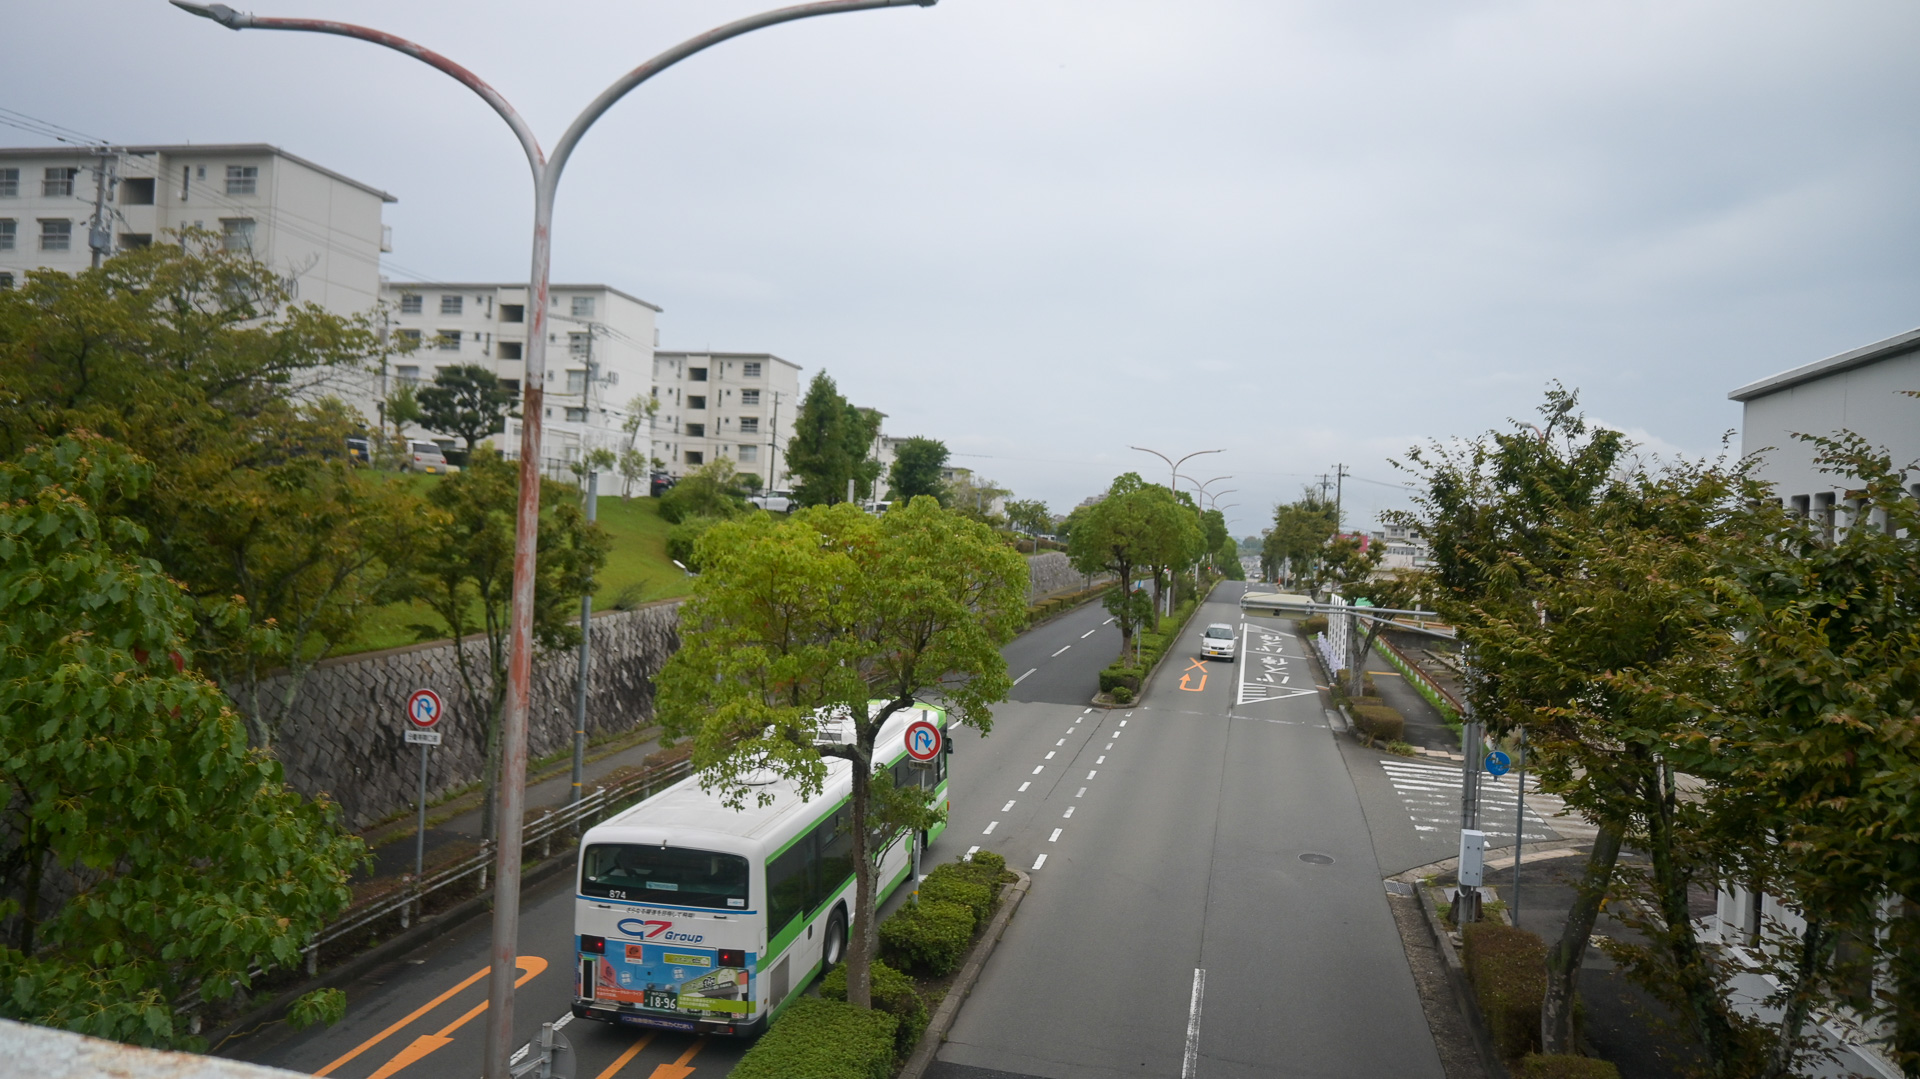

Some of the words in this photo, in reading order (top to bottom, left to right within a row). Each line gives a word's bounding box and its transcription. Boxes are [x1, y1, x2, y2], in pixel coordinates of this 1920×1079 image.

[609, 889, 627, 899] 874
[665, 931, 703, 943] Group
[650, 995, 676, 1010] 18-96
